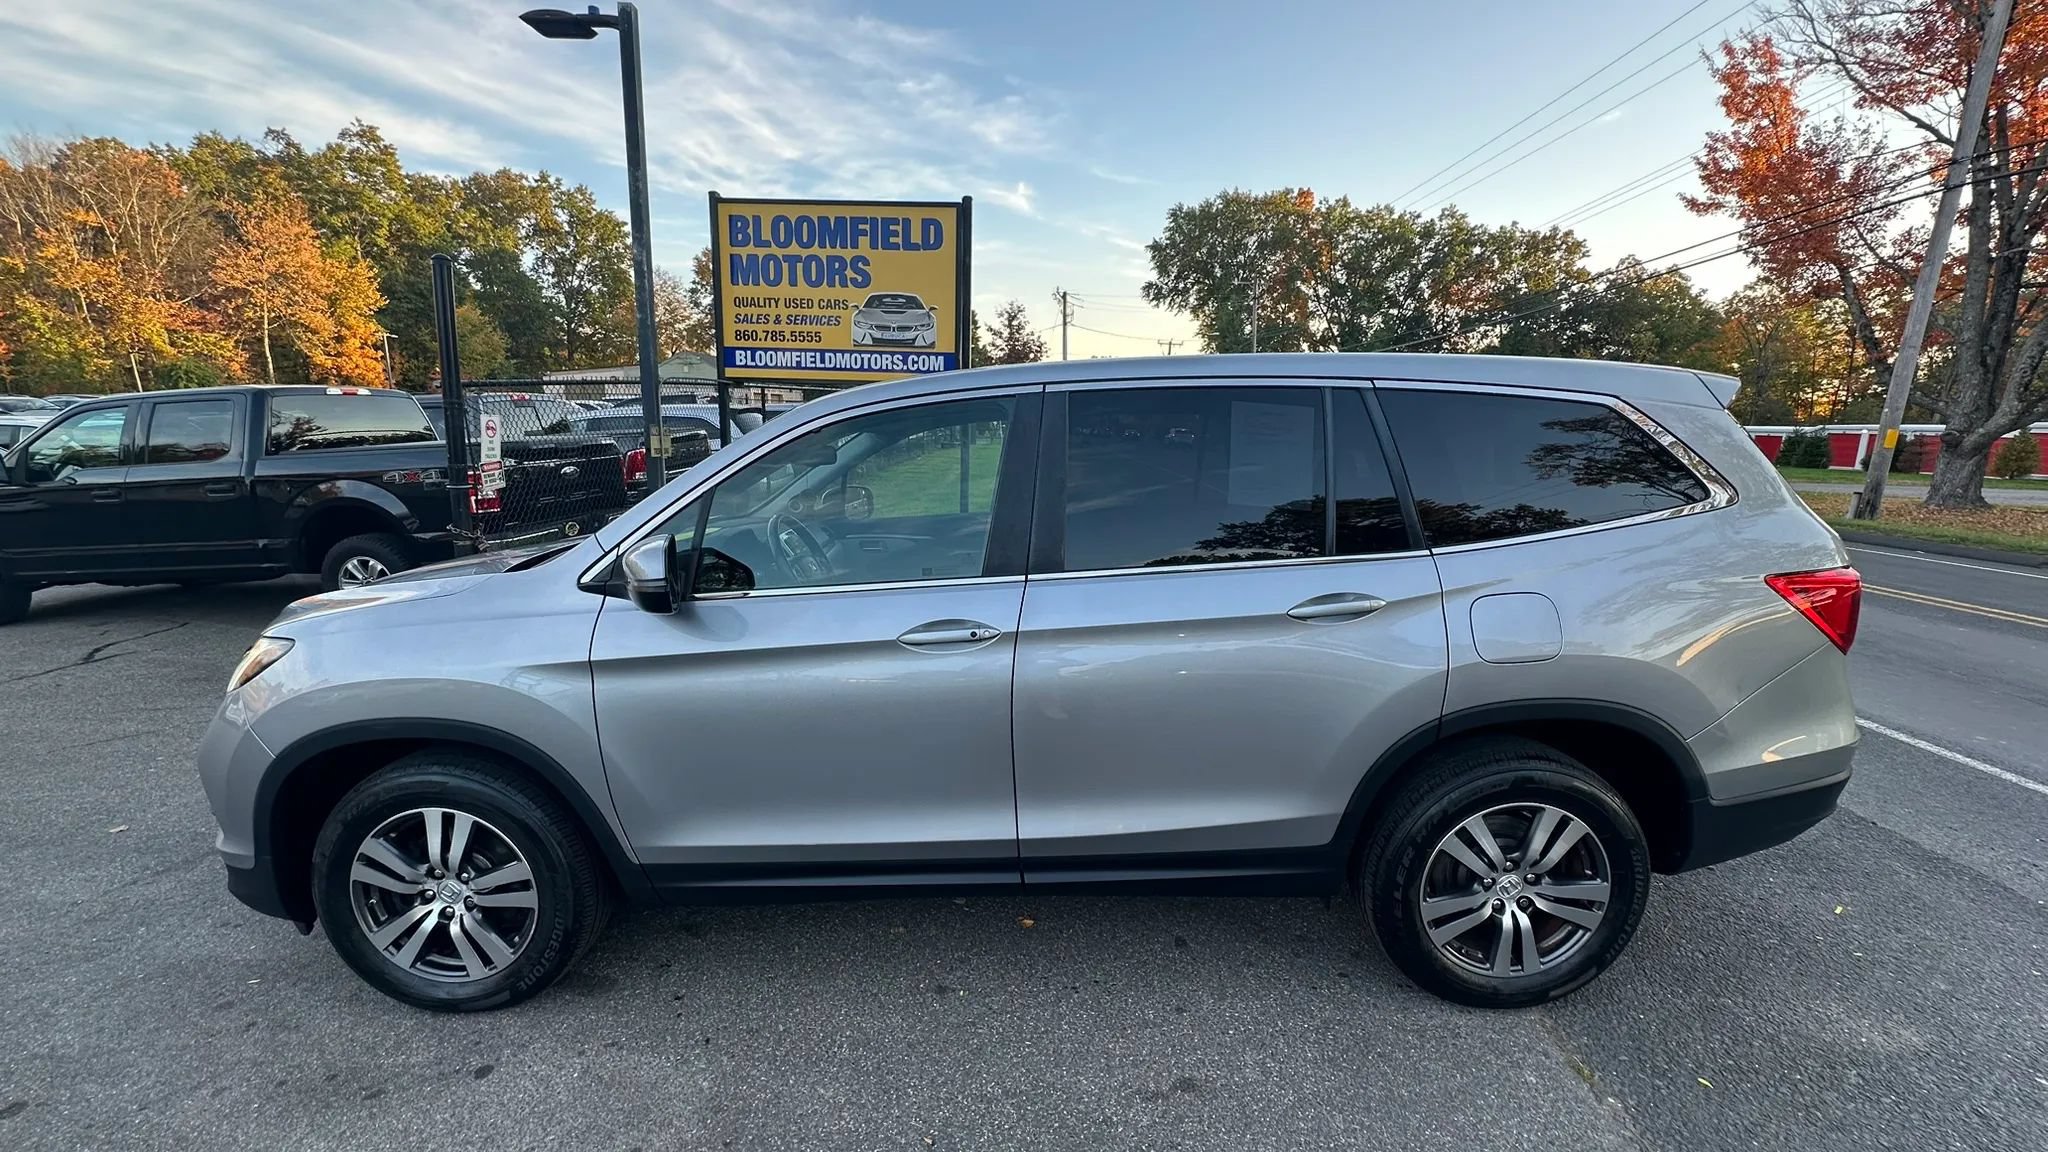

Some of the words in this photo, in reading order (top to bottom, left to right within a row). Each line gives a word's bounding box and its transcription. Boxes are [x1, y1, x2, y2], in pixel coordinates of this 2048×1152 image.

[728, 214, 944, 251] BLOOMFIELD
[729, 253, 872, 289] MOTORS
[733, 297, 780, 310] QUALITY
[784, 298, 814, 310] USED
[818, 299, 849, 311] CARS
[733, 313, 771, 325] SALES
[773, 314, 782, 325] &
[785, 315, 842, 327] SERVICES
[734, 330, 822, 343] 860.785.5555
[735, 350, 944, 371] BLOOMFIELDMOTORS.COM
